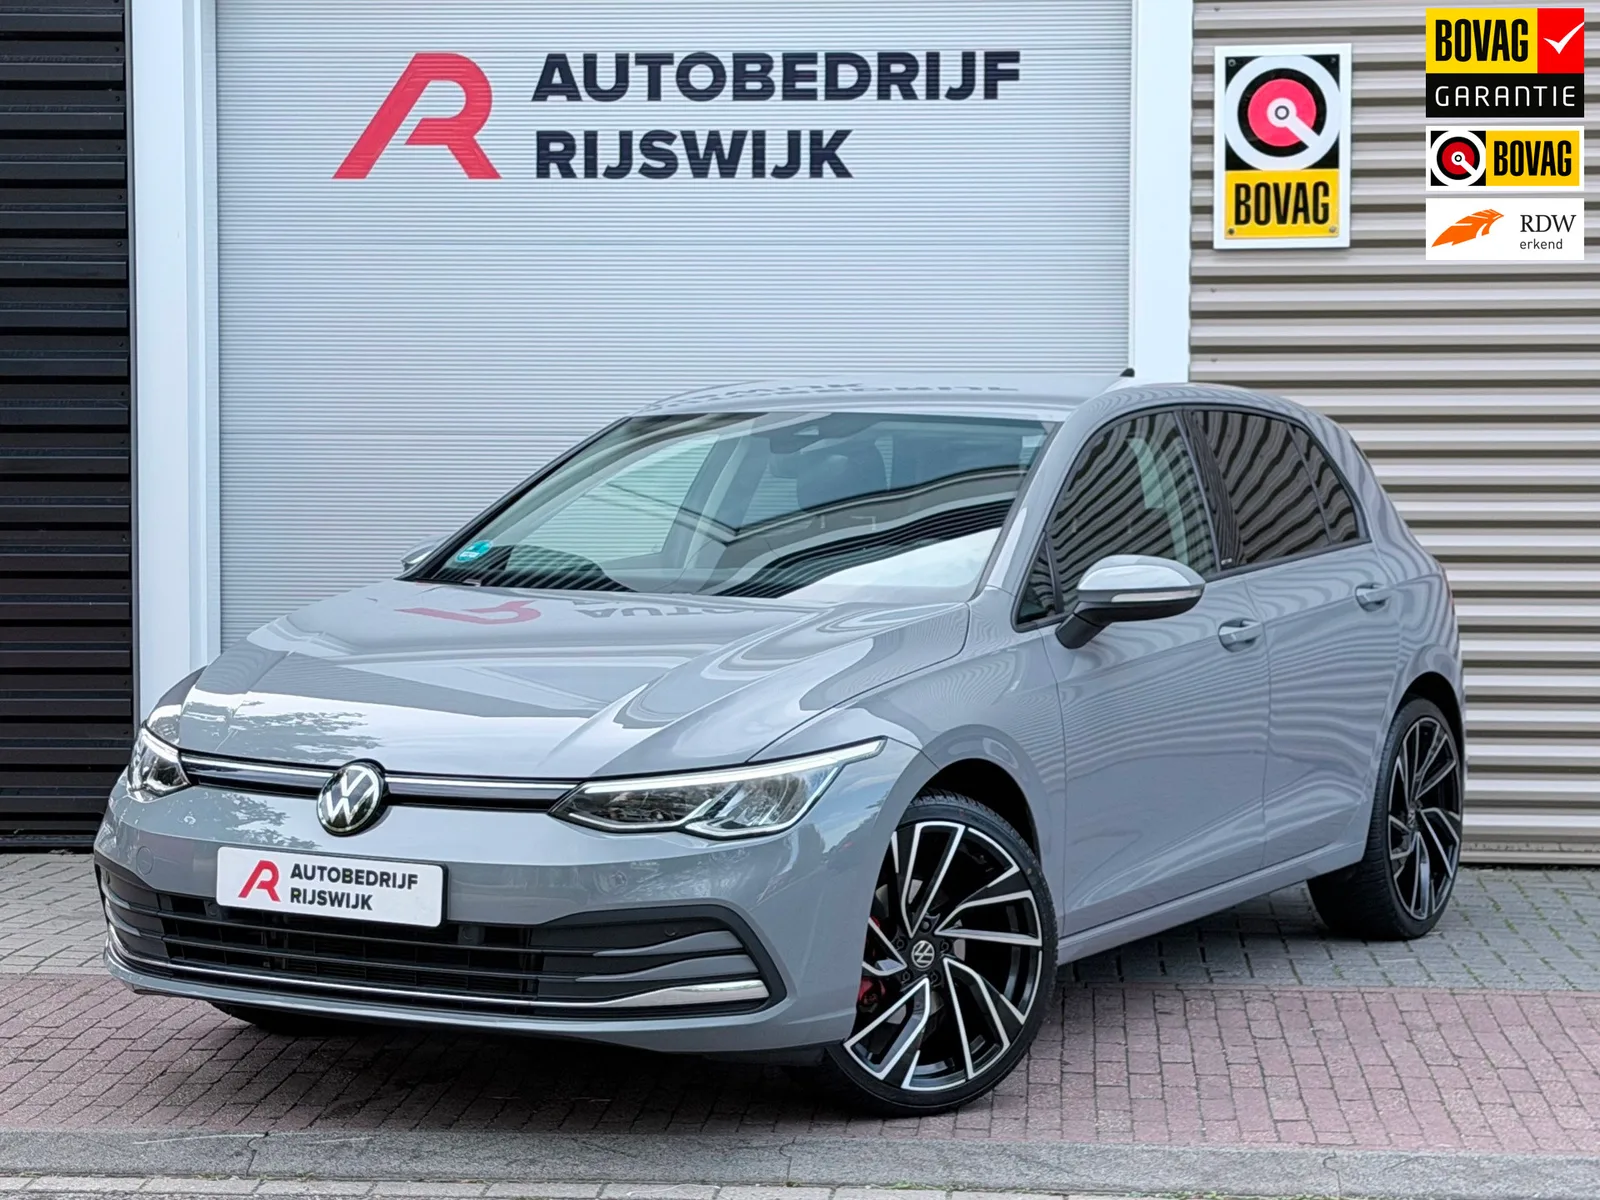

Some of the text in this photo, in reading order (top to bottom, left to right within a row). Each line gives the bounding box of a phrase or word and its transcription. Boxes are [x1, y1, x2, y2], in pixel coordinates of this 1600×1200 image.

[532, 50, 1021, 103] AUTOBEDRIJF
[535, 129, 853, 180] RIJSWIJK
[1234, 180, 1330, 226] BOVAG
[290, 863, 419, 890] AUTOBEDRIJF
[290, 887, 373, 911] RIJSWIJK
